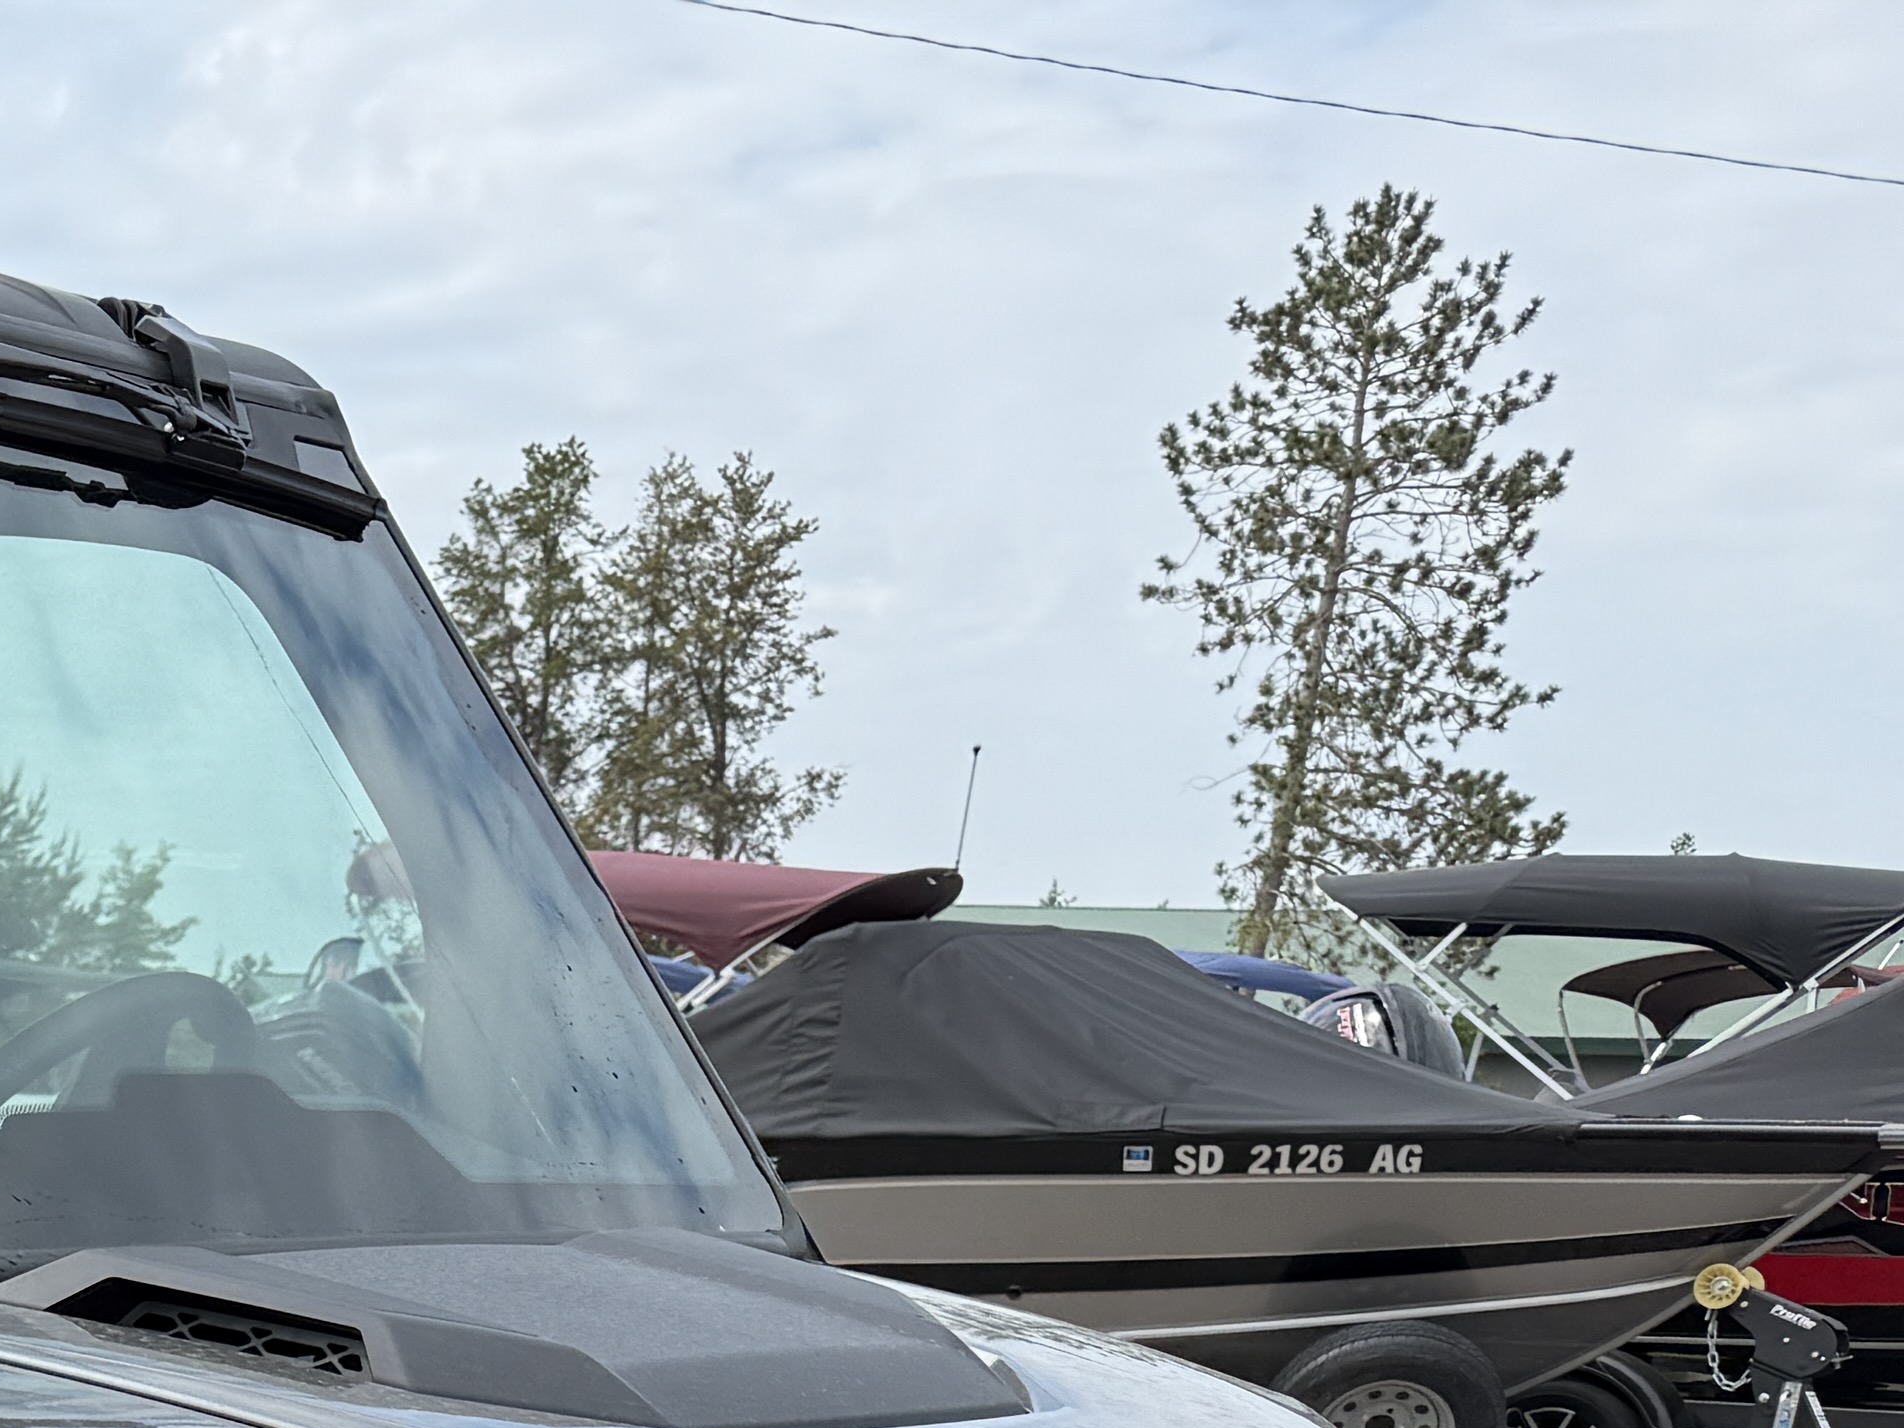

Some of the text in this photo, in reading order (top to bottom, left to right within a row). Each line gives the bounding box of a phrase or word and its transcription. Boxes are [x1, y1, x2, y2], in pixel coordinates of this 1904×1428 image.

[1173, 1143, 1424, 1176] SD 2126 AG
